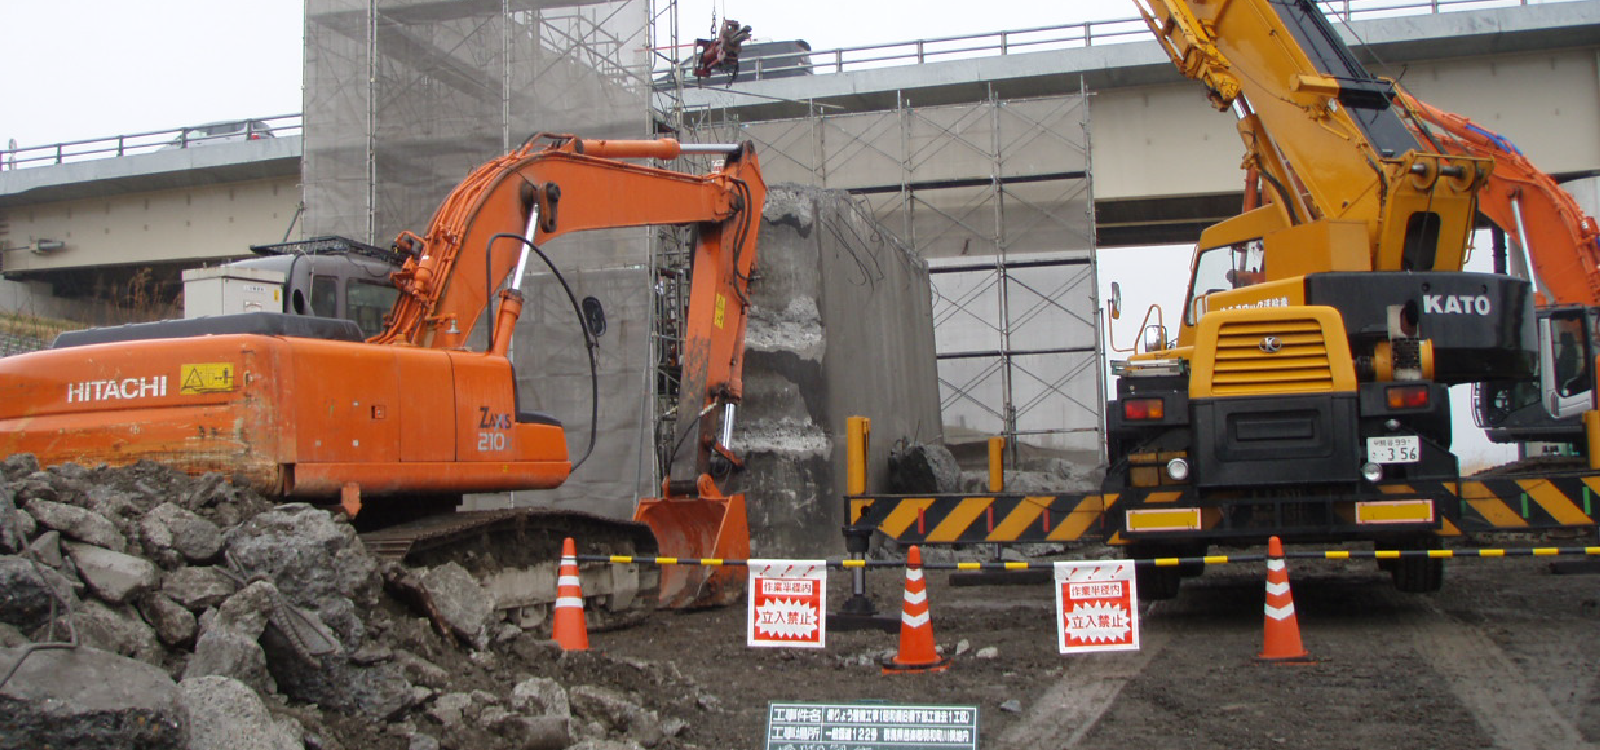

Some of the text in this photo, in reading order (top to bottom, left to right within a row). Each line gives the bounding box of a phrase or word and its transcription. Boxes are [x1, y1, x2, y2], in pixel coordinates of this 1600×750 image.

[1423, 294, 1490, 316] KATO
[67, 375, 168, 403] HITACHI
[764, 581, 812, 593] 作業半径内
[1072, 585, 1120, 596] 作業半径内
[761, 611, 812, 625] 立入禁止
[1072, 614, 1124, 629] 立入禁止
